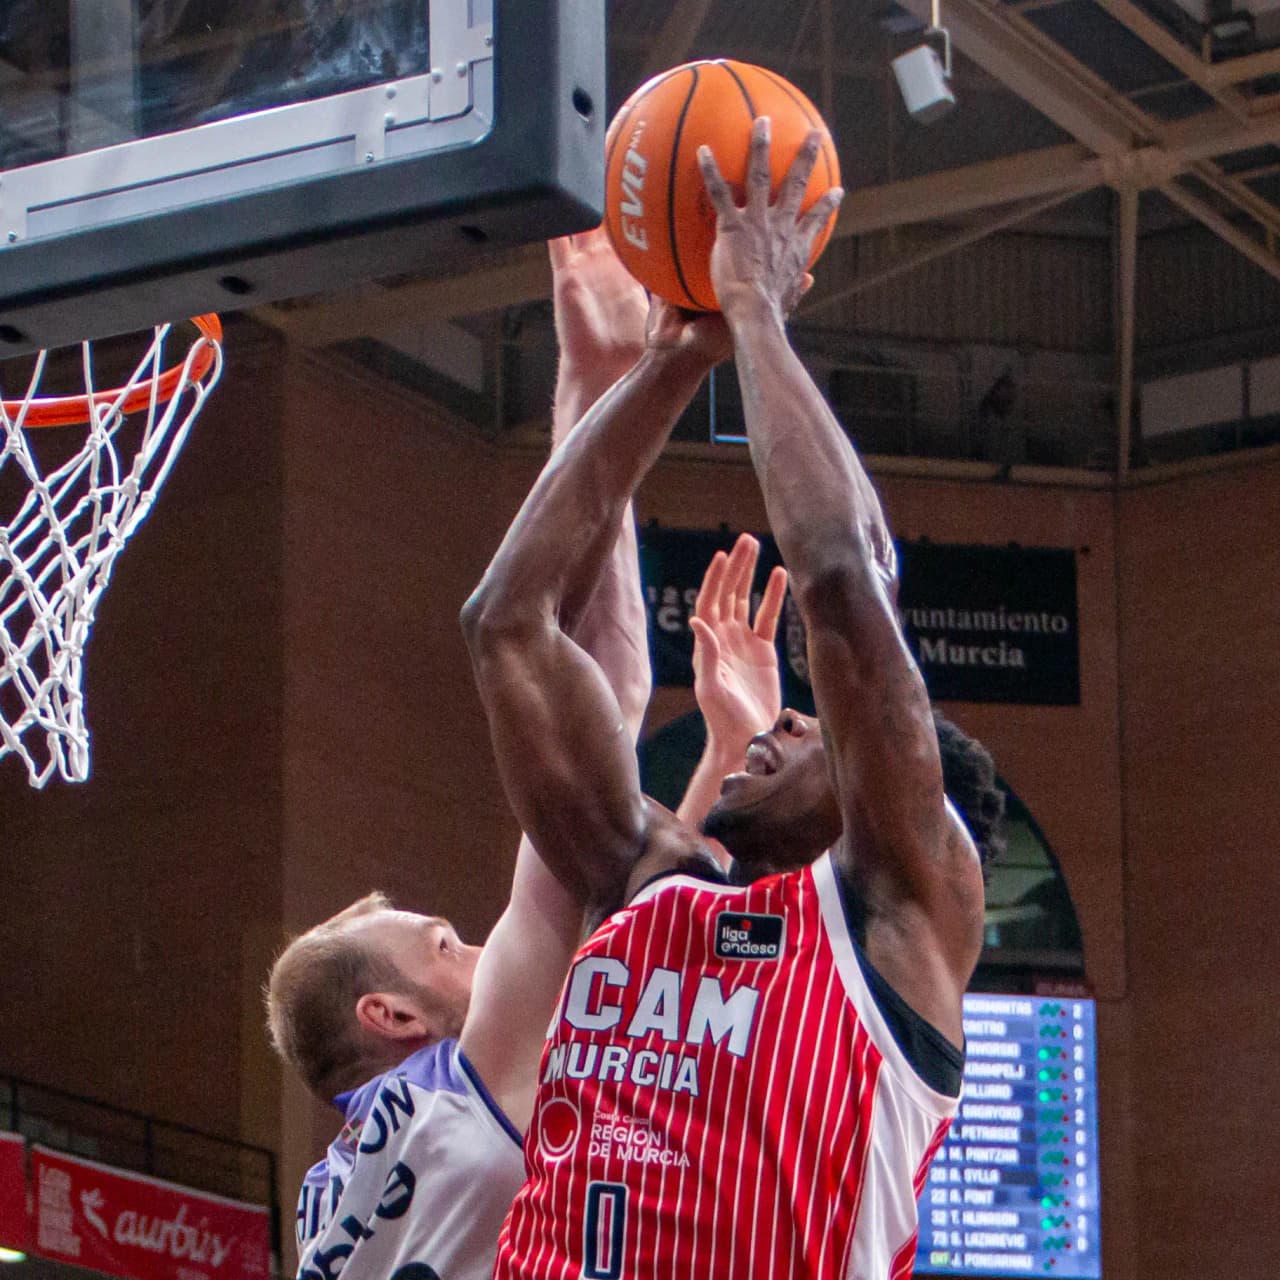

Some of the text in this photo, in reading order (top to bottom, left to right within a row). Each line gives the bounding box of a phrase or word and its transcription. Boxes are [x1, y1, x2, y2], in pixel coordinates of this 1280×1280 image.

[920, 637, 1025, 667] Murcia
[721, 941, 777, 954] endesa
[722, 926, 748, 942] liga
[547, 956, 760, 1058] CAM
[542, 1041, 699, 1097] MURCIA
[588, 1141, 691, 1168] DE MURCIA
